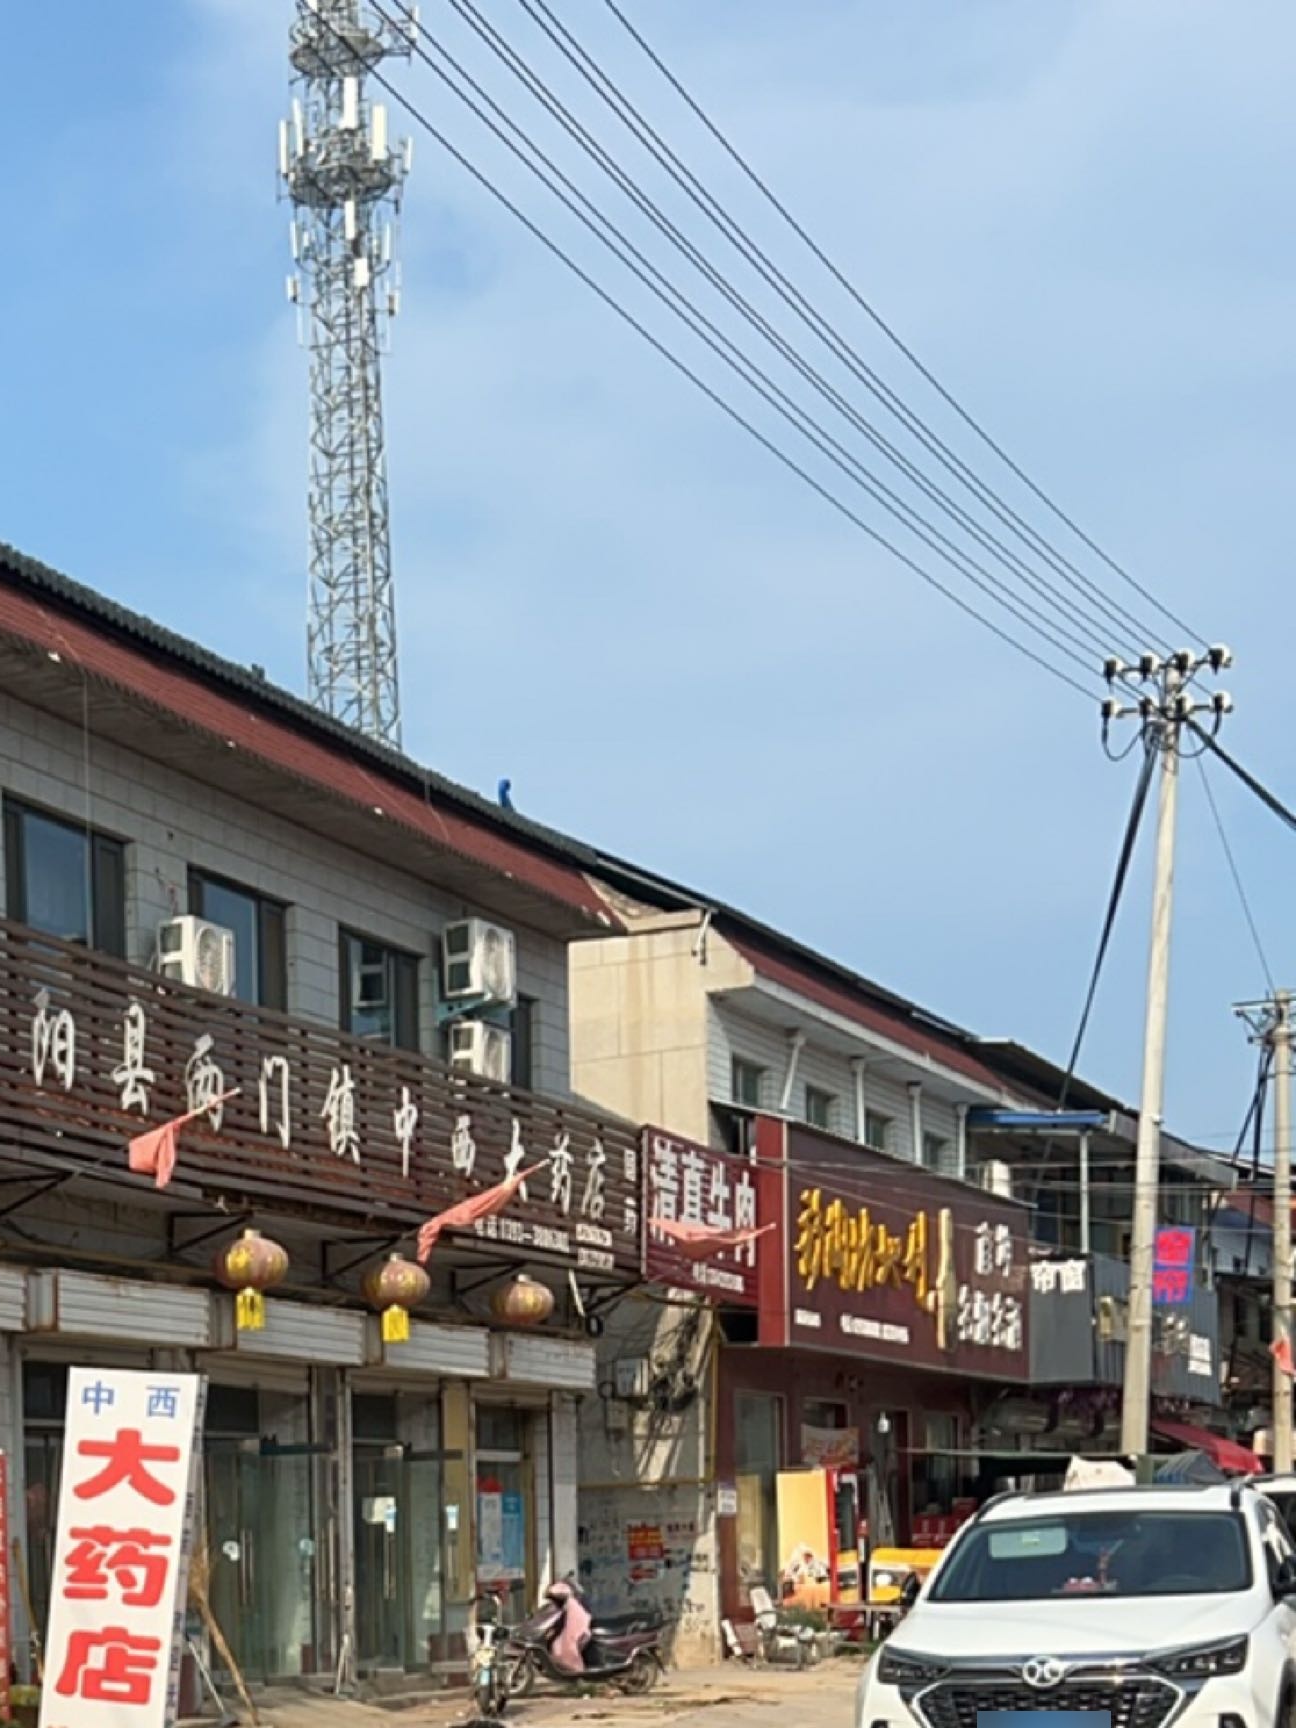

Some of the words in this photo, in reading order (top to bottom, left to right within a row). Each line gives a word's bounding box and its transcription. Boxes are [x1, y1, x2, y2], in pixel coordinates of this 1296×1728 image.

[82, 1380, 181, 1419] 中西
[55, 1428, 181, 1706] 大药店
